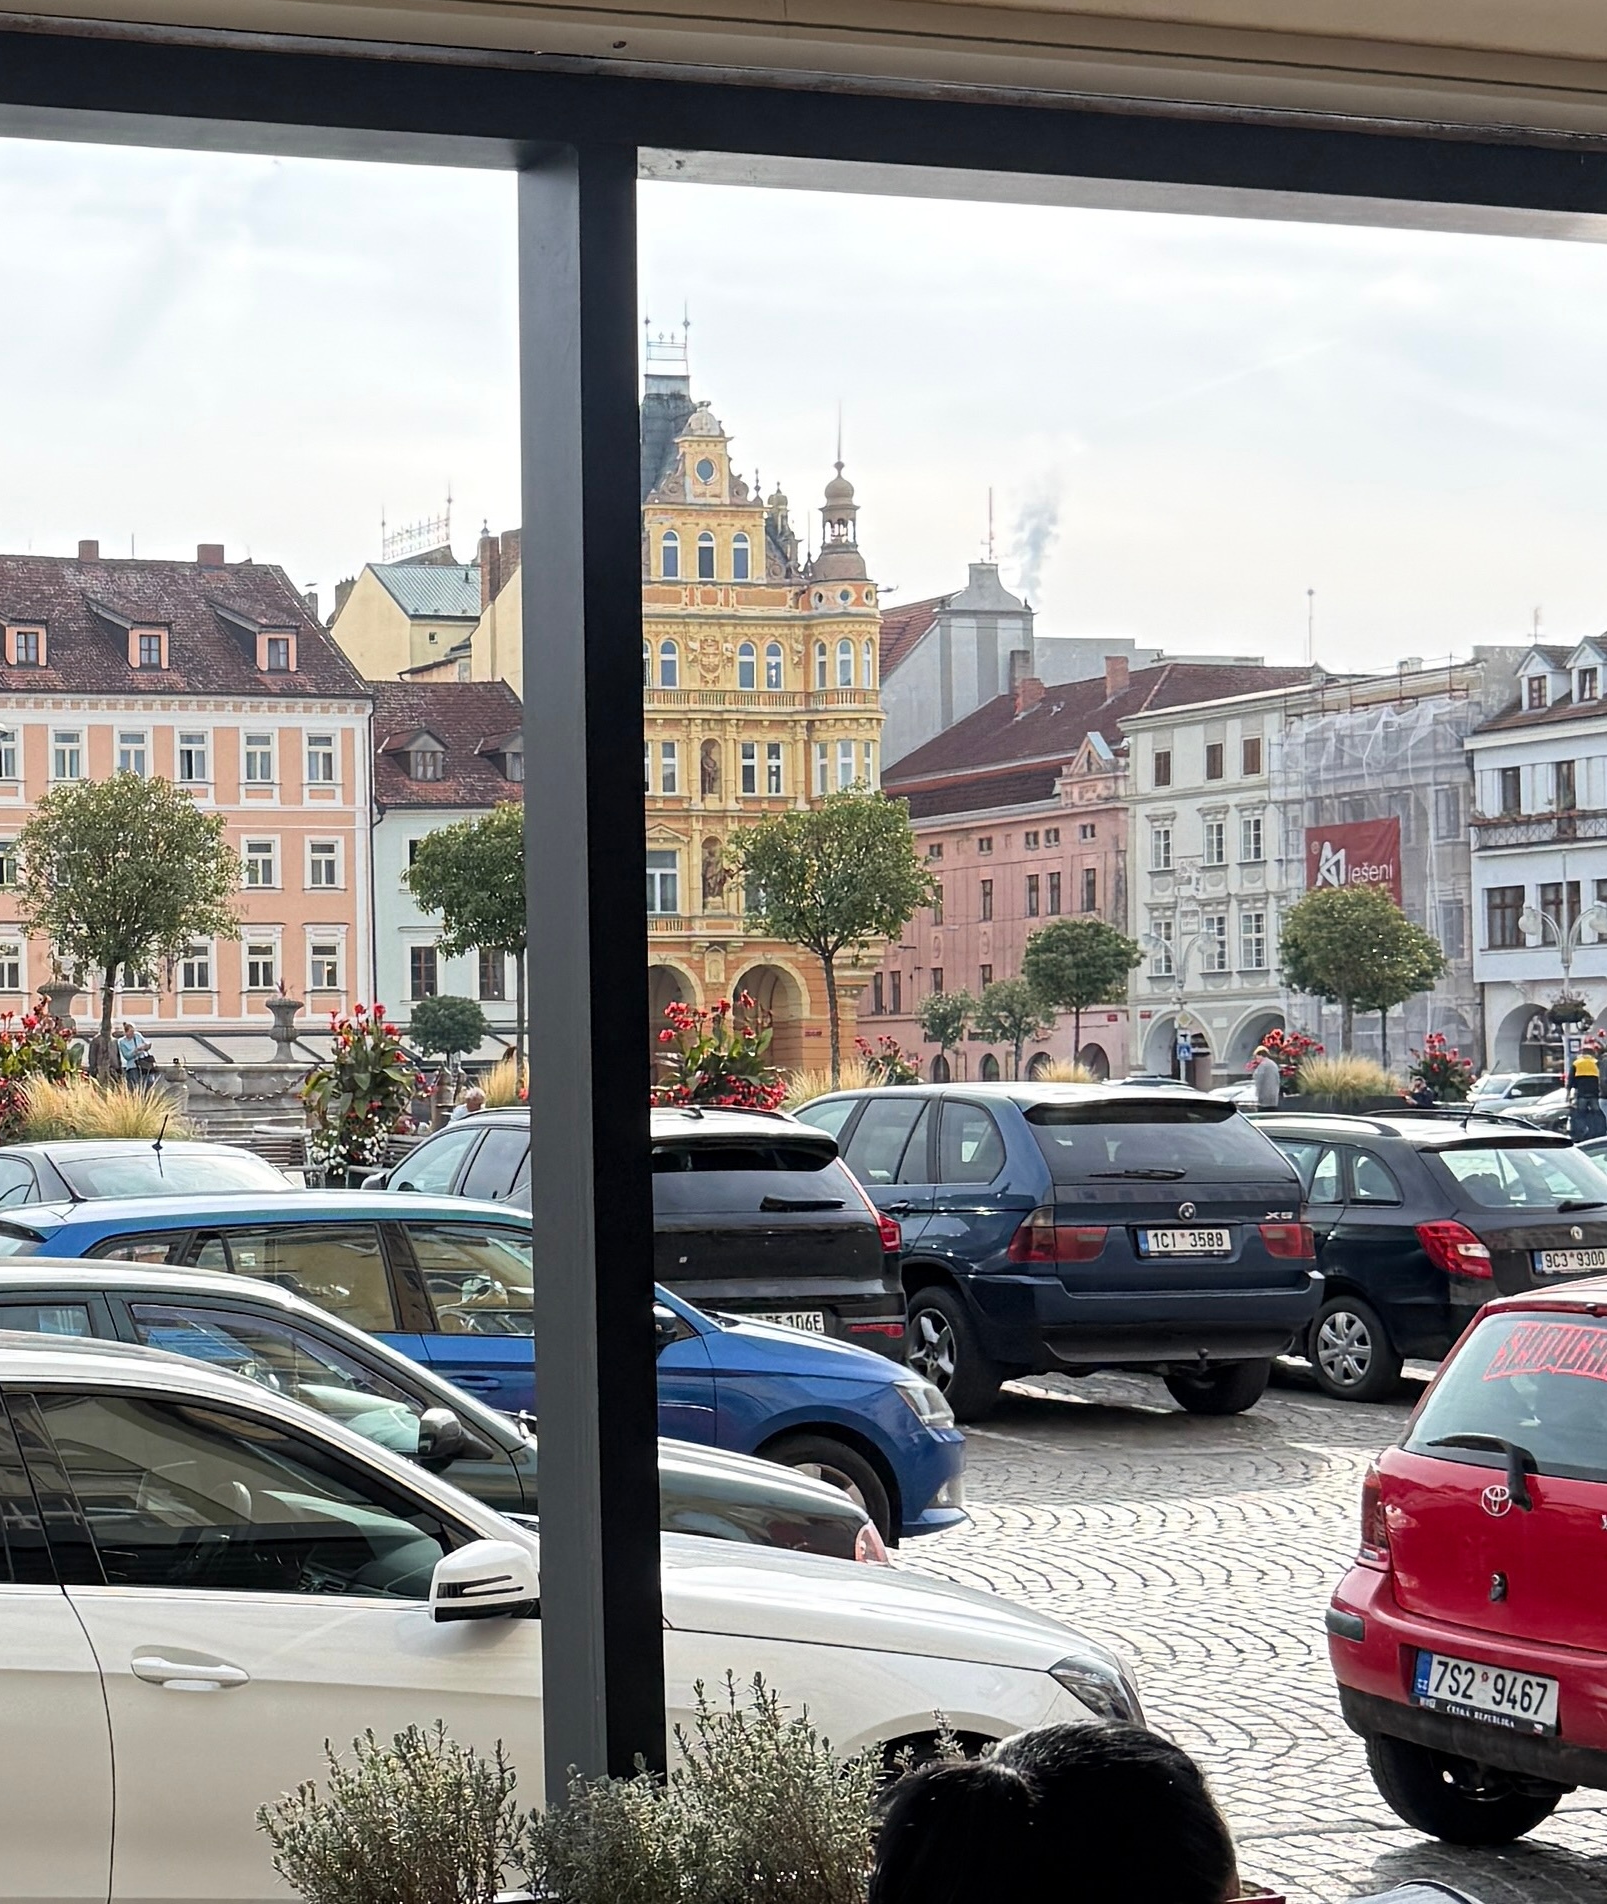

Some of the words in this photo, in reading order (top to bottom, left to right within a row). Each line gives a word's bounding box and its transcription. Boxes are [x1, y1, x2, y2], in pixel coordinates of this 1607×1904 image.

[1152, 1233, 1176, 1249] 1CI
[1545, 1253, 1568, 1268] 9C3
[1577, 1251, 1605, 1267] 9300
[1434, 1660, 1476, 1700] 7S2
[1492, 1673, 1548, 1716] 9467
